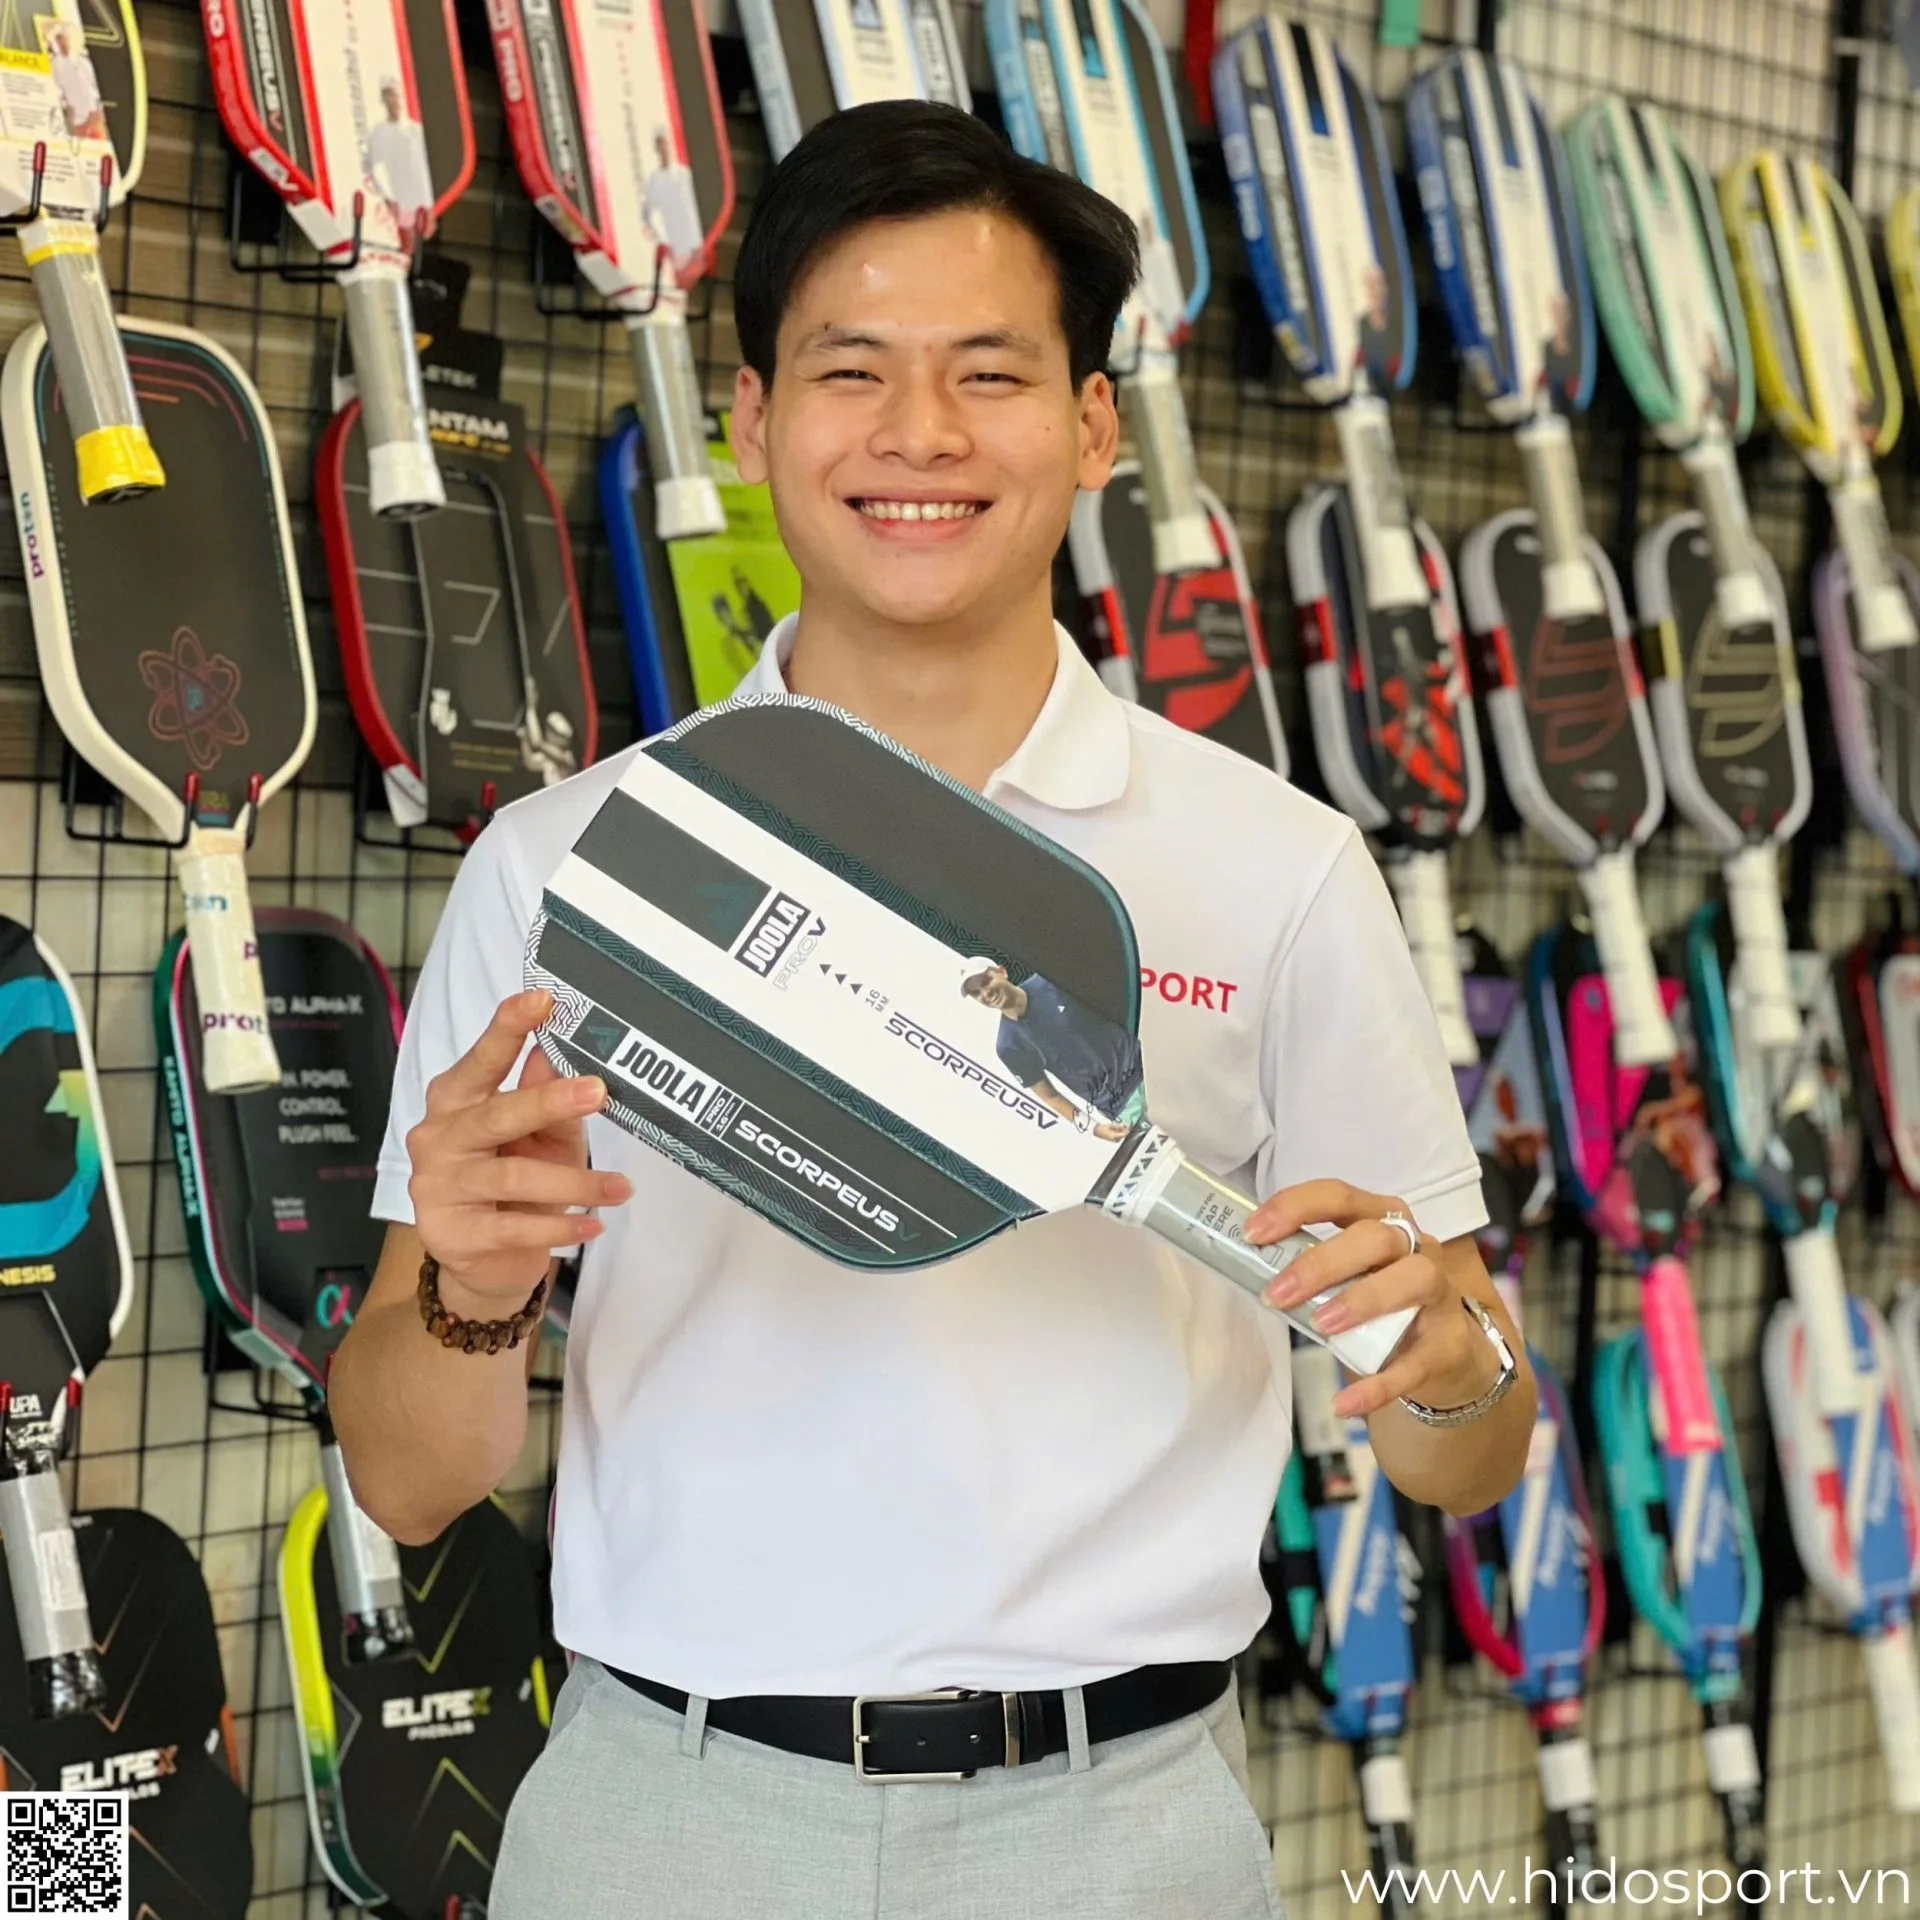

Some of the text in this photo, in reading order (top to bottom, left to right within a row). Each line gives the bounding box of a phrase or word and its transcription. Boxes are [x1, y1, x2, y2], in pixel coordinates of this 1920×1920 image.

[745, 900, 805, 974] JOOLA
[865, 989, 881, 1008] 16
[616, 1040, 707, 1116] JOOLA
[884, 1014, 1058, 1130] SCORPEUSV
[706, 1097, 726, 1124] PRO
[1206, 1204, 1234, 1241] ERE
[10, 1394, 42, 1414] UPA
